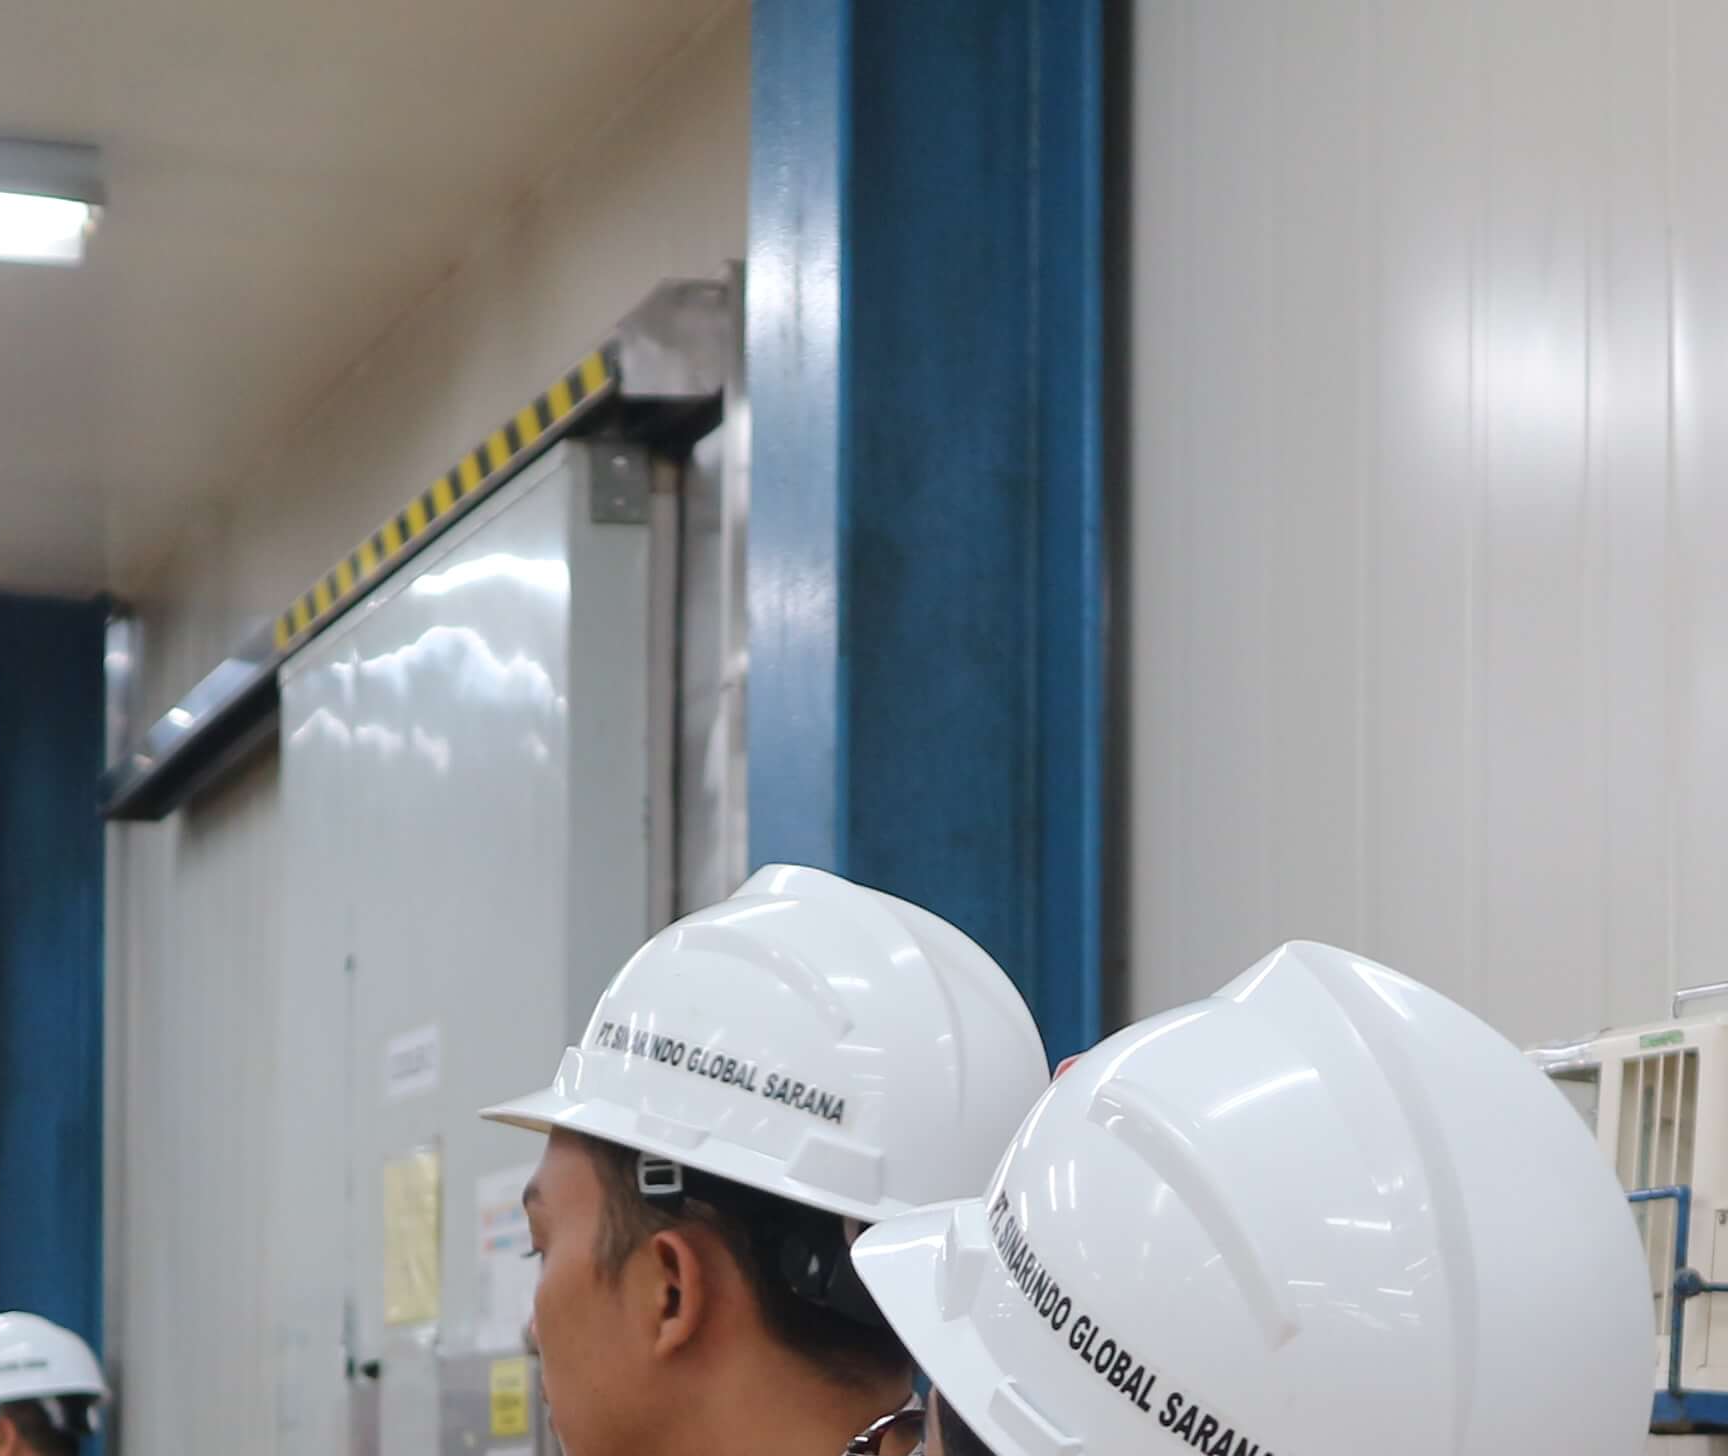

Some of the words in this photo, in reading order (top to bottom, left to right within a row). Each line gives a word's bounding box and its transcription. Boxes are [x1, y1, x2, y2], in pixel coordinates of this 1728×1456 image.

[685, 1047, 758, 1094] GLOBAL
[763, 1071, 847, 1126] SARANA
[996, 1215, 1072, 1332] SINARINDO
[1068, 1314, 1157, 1413] GLOBAL
